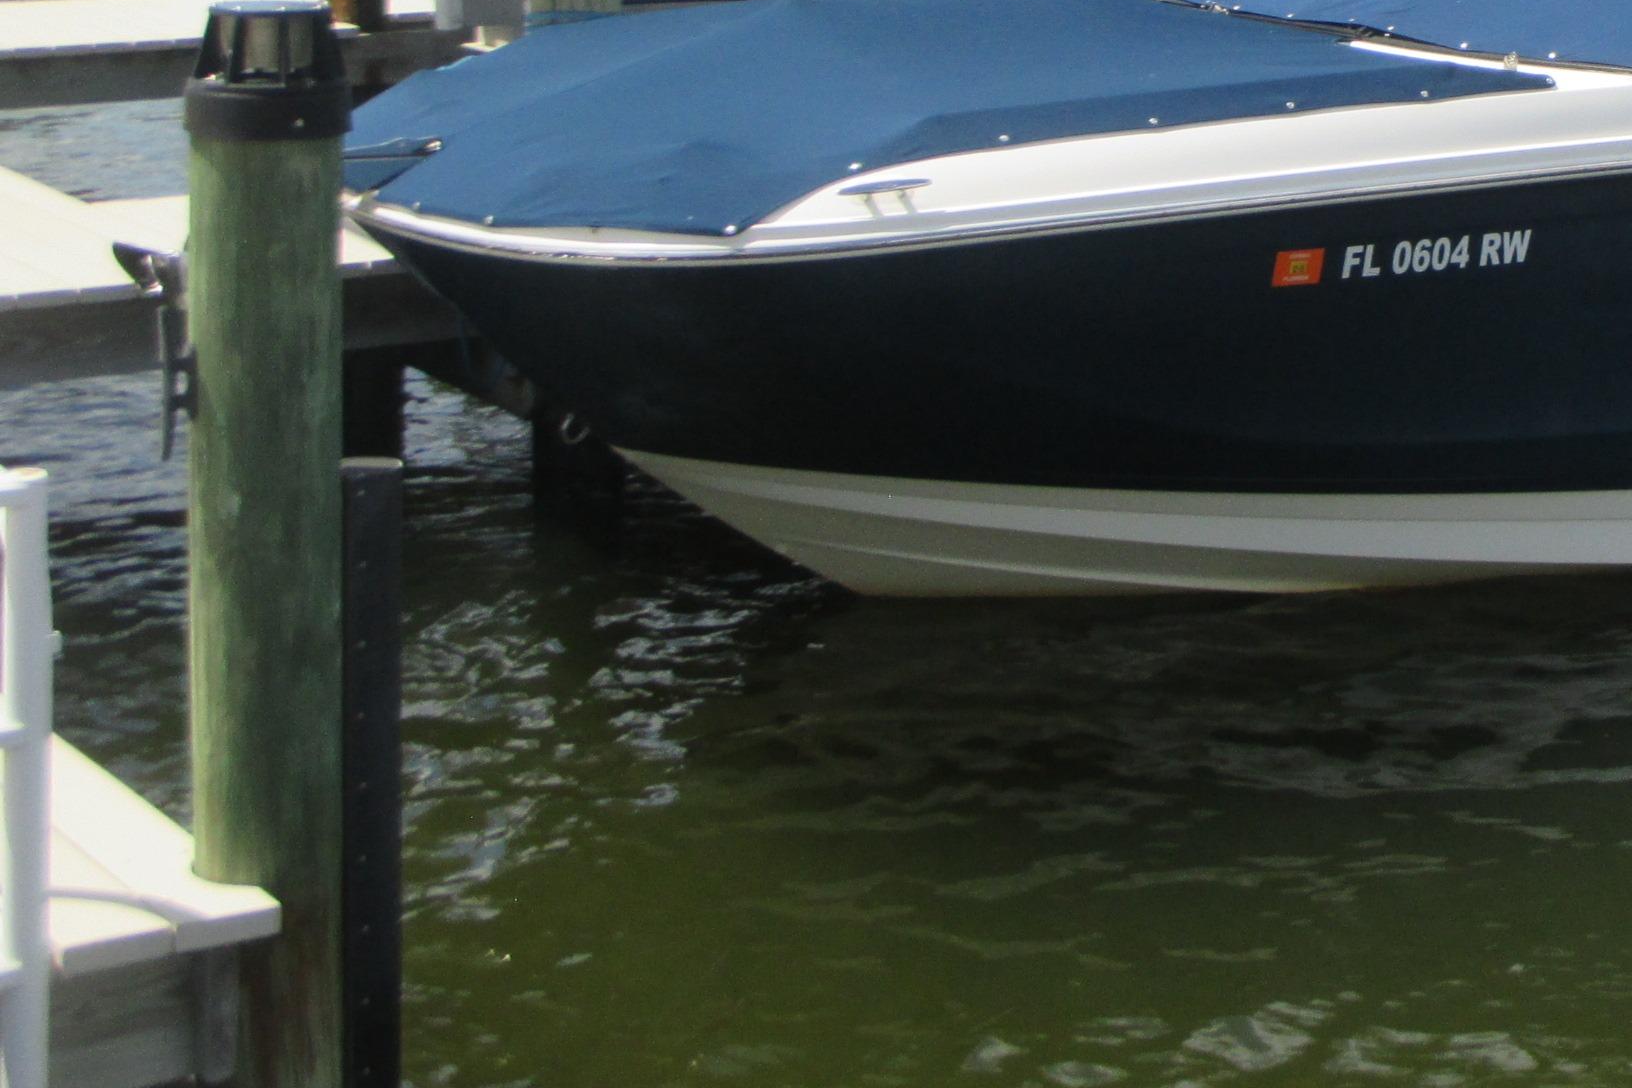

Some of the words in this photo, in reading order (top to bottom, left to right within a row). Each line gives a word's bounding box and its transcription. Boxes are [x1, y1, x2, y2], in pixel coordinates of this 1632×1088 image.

[1341, 244, 1380, 279] FL
[1392, 235, 1470, 275] 0604
[1479, 229, 1532, 267] RW
